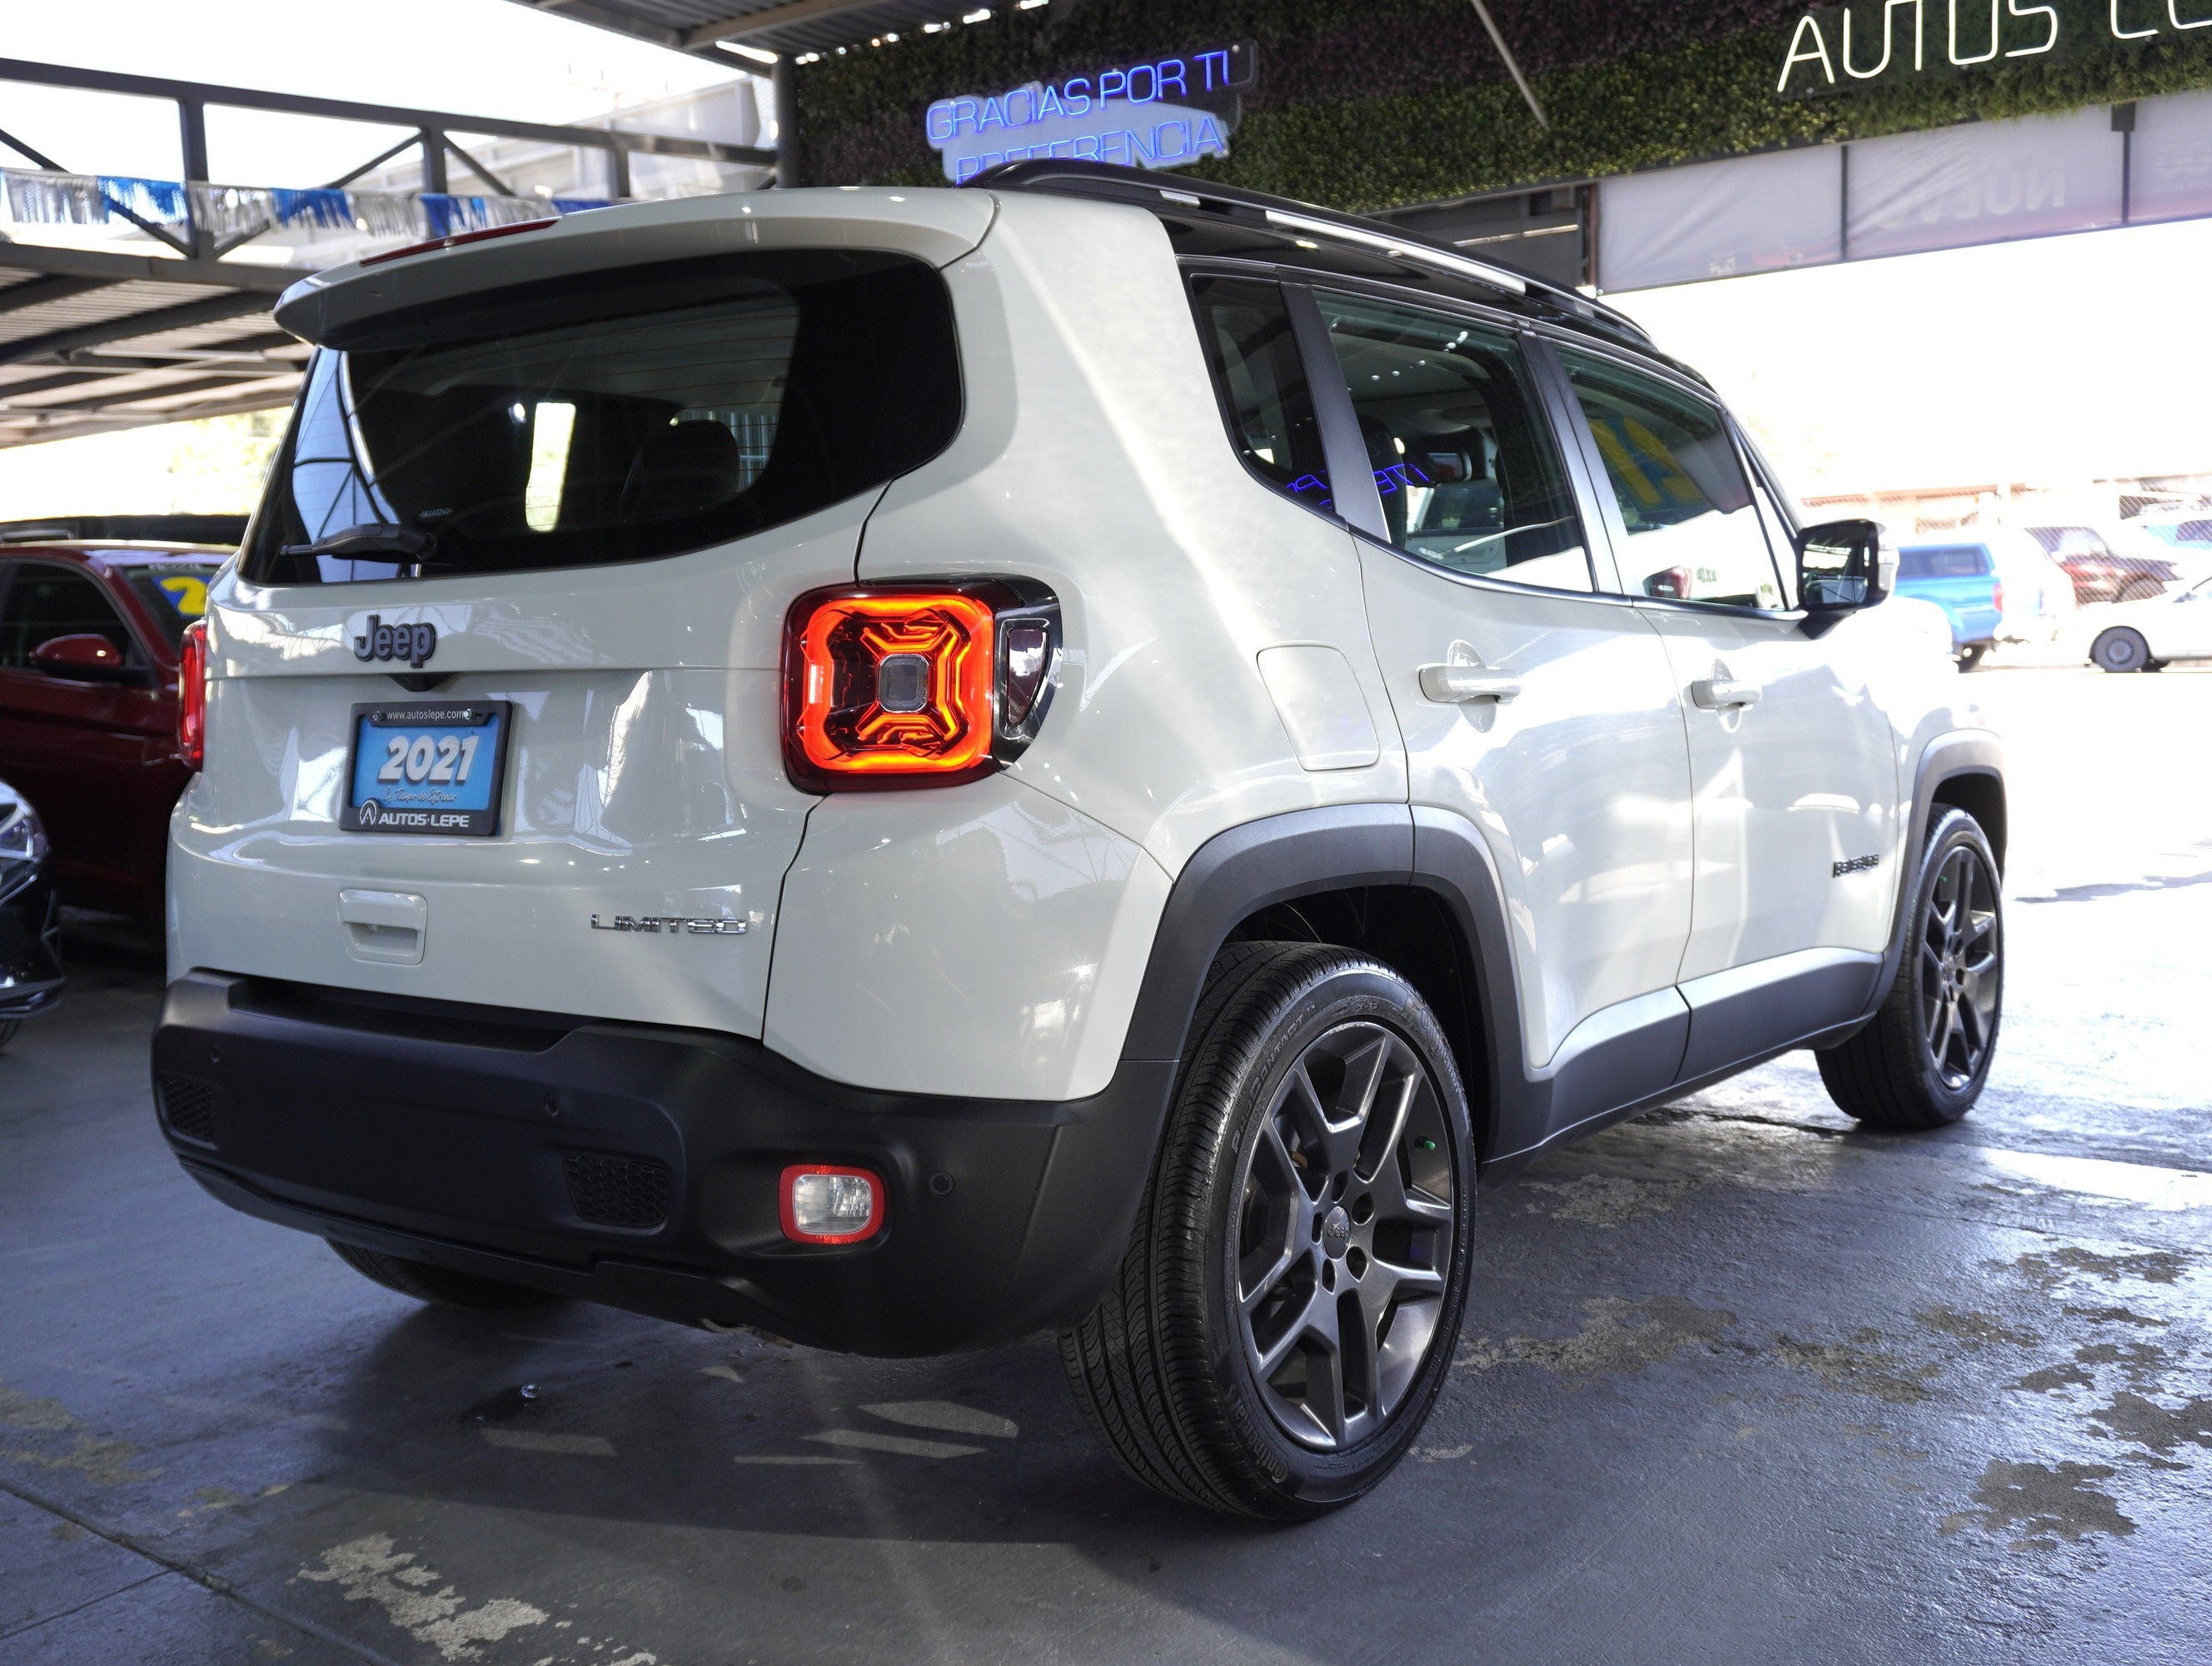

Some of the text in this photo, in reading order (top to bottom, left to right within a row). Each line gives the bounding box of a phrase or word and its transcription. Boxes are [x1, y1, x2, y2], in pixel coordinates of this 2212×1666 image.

[1776, 0, 2058, 93] AUTOS
[926, 49, 1229, 142] GRACIAS POR TI
[354, 614, 437, 668] Jeep
[386, 708, 465, 721] www.autoslepe.com
[377, 735, 480, 783] 2021
[378, 813, 470, 828] AUTOS LEPE
[590, 914, 747, 935] LIMITED
